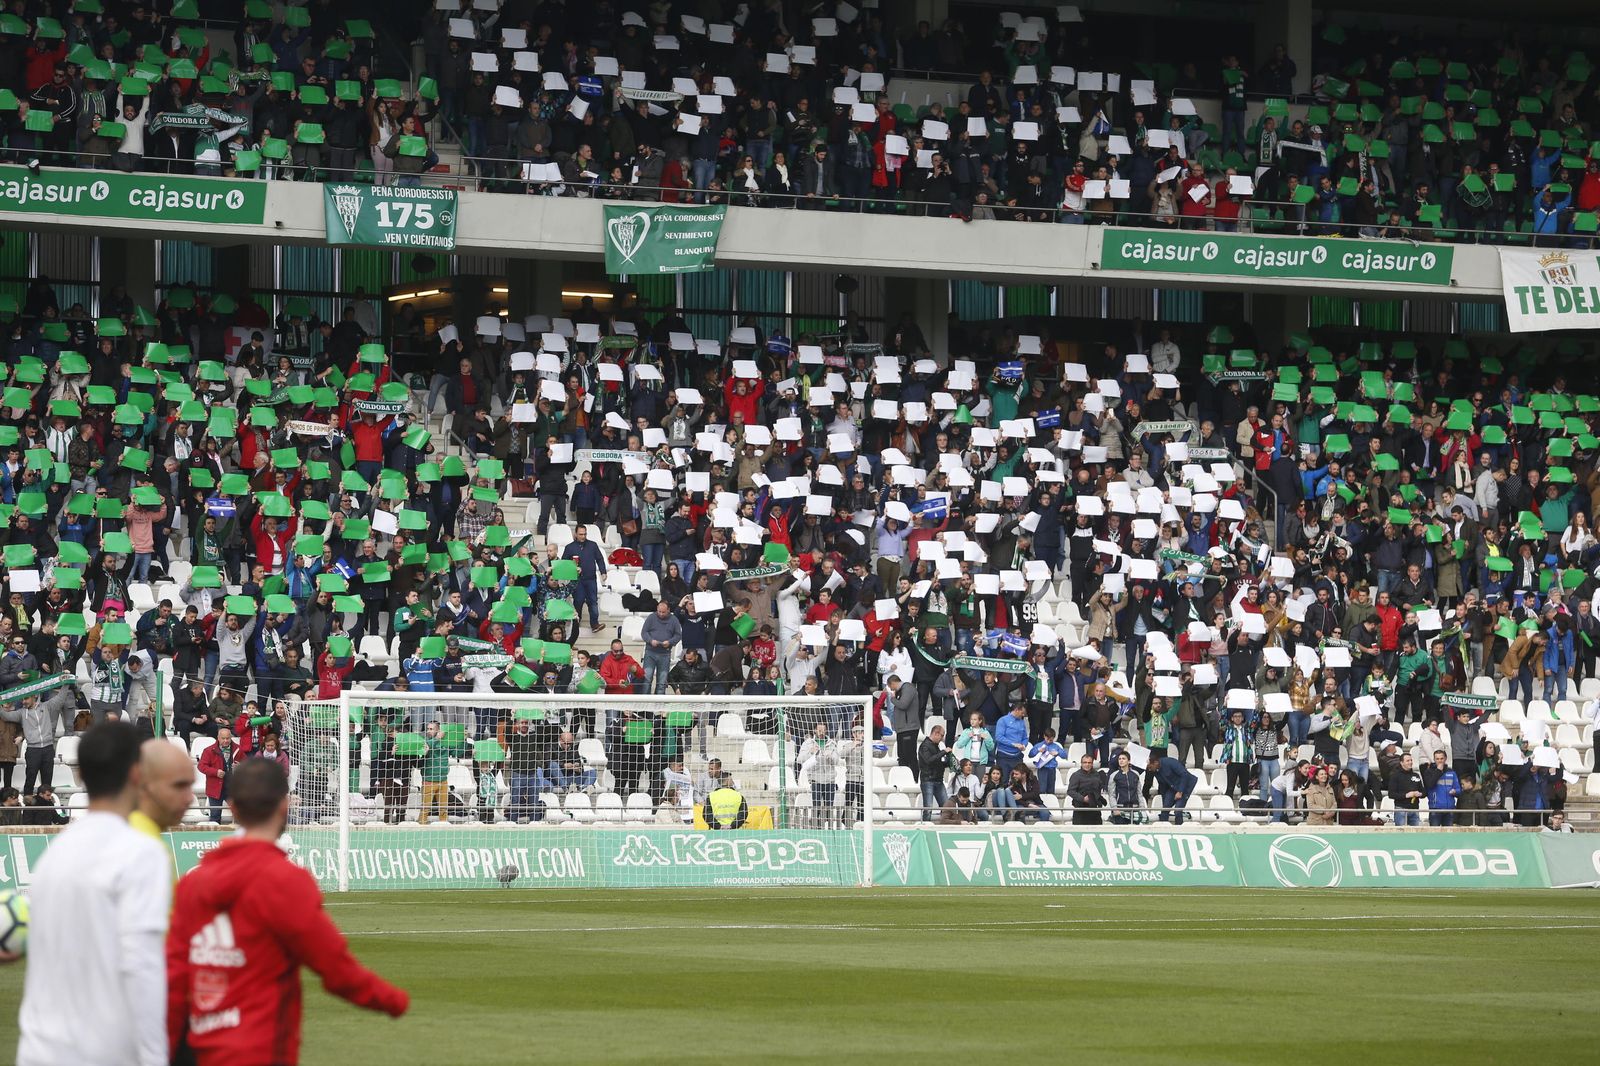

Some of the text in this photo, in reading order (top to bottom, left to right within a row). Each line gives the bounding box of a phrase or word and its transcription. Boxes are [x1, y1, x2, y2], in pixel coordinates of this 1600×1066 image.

[129, 184, 223, 212] cajasur
[395, 187, 454, 200] CORDOBESISTA
[375, 201, 435, 229] 175
[403, 234, 410, 244] Y
[411, 233, 454, 248] CUÉNTANOS
[664, 231, 713, 240] SENTIMIENTO
[1121, 239, 1200, 264] cajasur
[1233, 245, 1309, 270] cajasur
[1342, 249, 1418, 274] cajasur
[1514, 286, 1548, 315] TE
[970, 657, 1010, 669] CÓRDOBA
[1448, 695, 1493, 707] CÓRDOBA CF
[181, 841, 223, 850] APREN
[670, 834, 830, 870] Kappa
[998, 832, 1225, 872] TAMESUR
[713, 877, 770, 885] PATROCINADOR
[1008, 870, 1163, 882] CINTAS TRANSPORTADORAS
